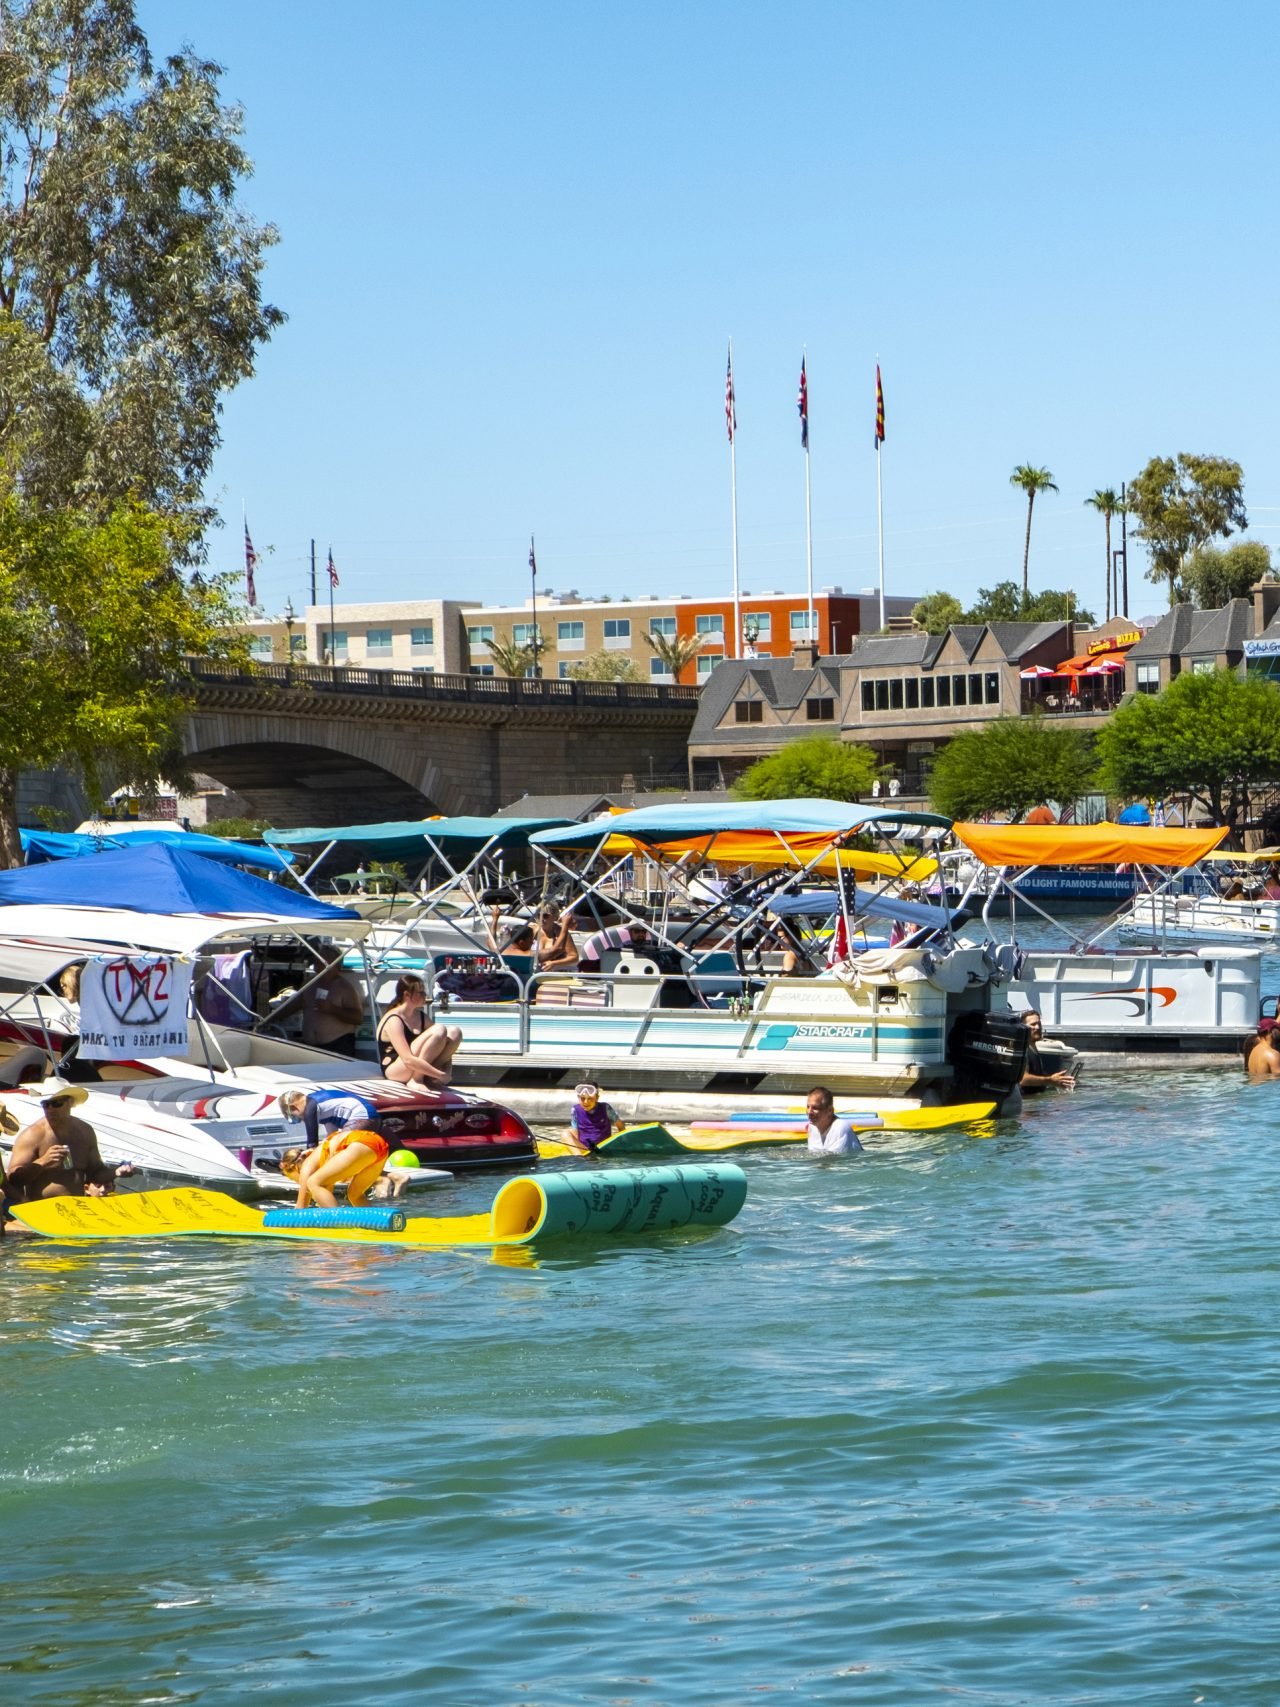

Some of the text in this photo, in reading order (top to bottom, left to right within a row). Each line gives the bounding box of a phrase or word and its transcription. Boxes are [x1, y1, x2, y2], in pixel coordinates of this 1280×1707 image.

[1032, 879, 1058, 887] LIGHT
[1060, 879, 1096, 888] FAMOUS
[1098, 880, 1130, 889] AMONG
[108, 963, 169, 1002] TMZ
[799, 1025, 868, 1038] STARCRAFT
[112, 1036, 125, 1048] TV
[972, 1041, 1008, 1054] MERCURY
